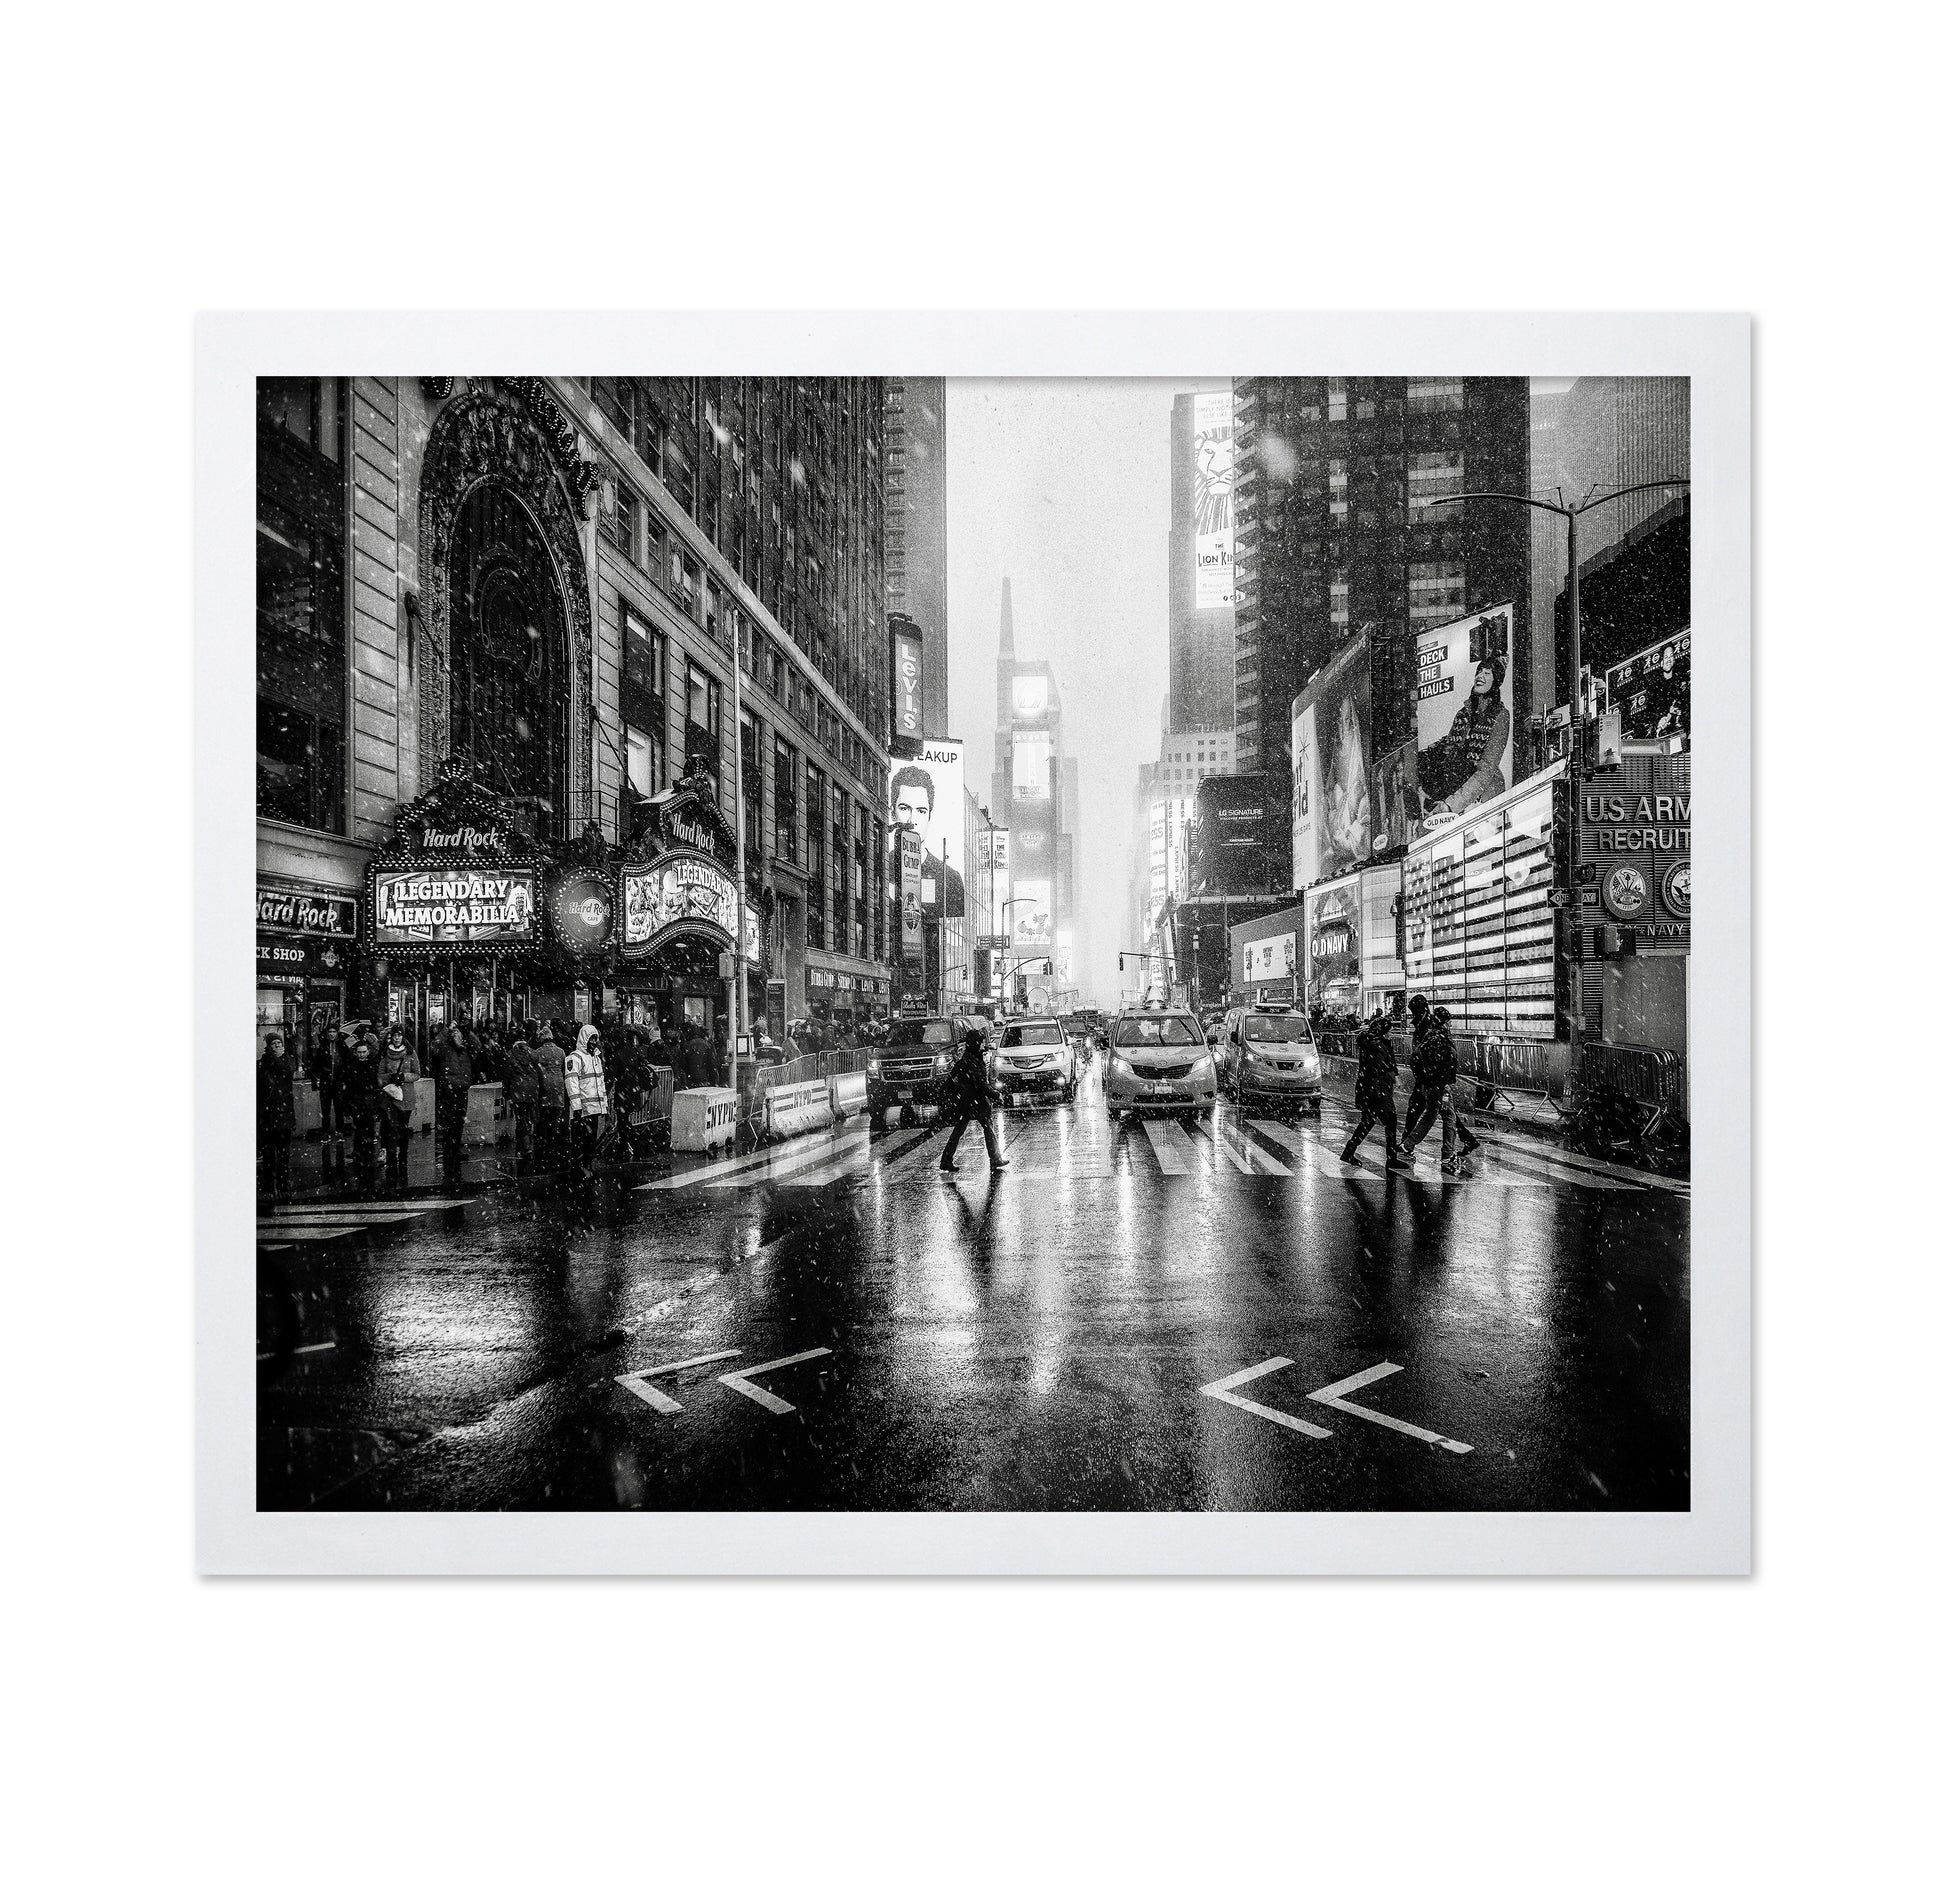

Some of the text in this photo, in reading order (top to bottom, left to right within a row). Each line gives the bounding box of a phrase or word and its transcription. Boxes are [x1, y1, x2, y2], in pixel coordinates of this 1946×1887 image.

[1198, 553, 1218, 567] LION
[1420, 648, 1445, 667] DECK
[1420, 667, 1437, 682] THE
[1420, 680, 1450, 699] HAULS
[1428, 815, 1456, 827] OLD NAVY
[423, 827, 499, 851] Hard Rock
[673, 811, 715, 857] Hard Rock
[397, 880, 509, 901] LEGENDARY
[297, 898, 338, 933] Rock
[385, 905, 520, 926] MEMORABILIA
[569, 901, 611, 918] Hard Rock
[1647, 923, 1684, 937] NAVY
[1327, 933, 1349, 956] NAVY
[273, 948, 305, 962] SHOP
[710, 1101, 734, 1129] NYPD
